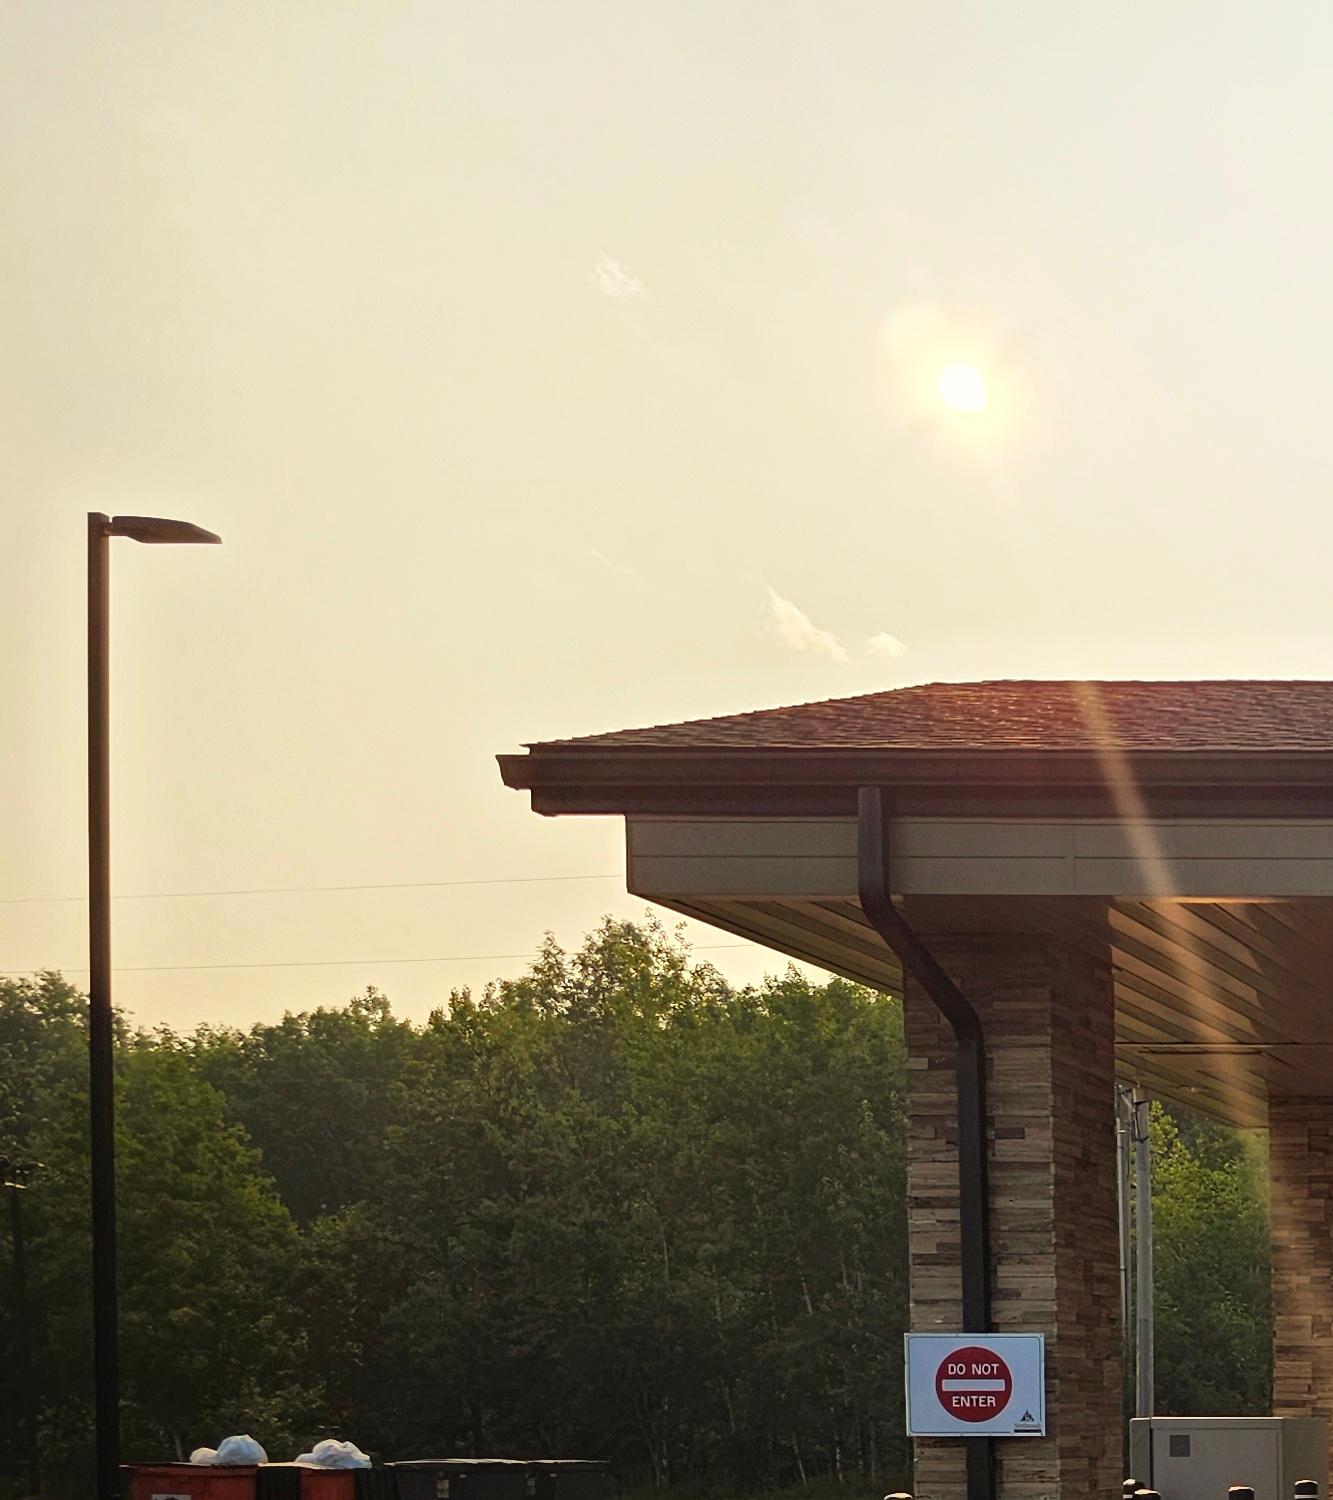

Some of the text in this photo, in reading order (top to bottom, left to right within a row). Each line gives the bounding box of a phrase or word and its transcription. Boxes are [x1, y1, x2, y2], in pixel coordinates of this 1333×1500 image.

[948, 1363, 999, 1375] DO NOT
[952, 1395, 996, 1407] ENTER
